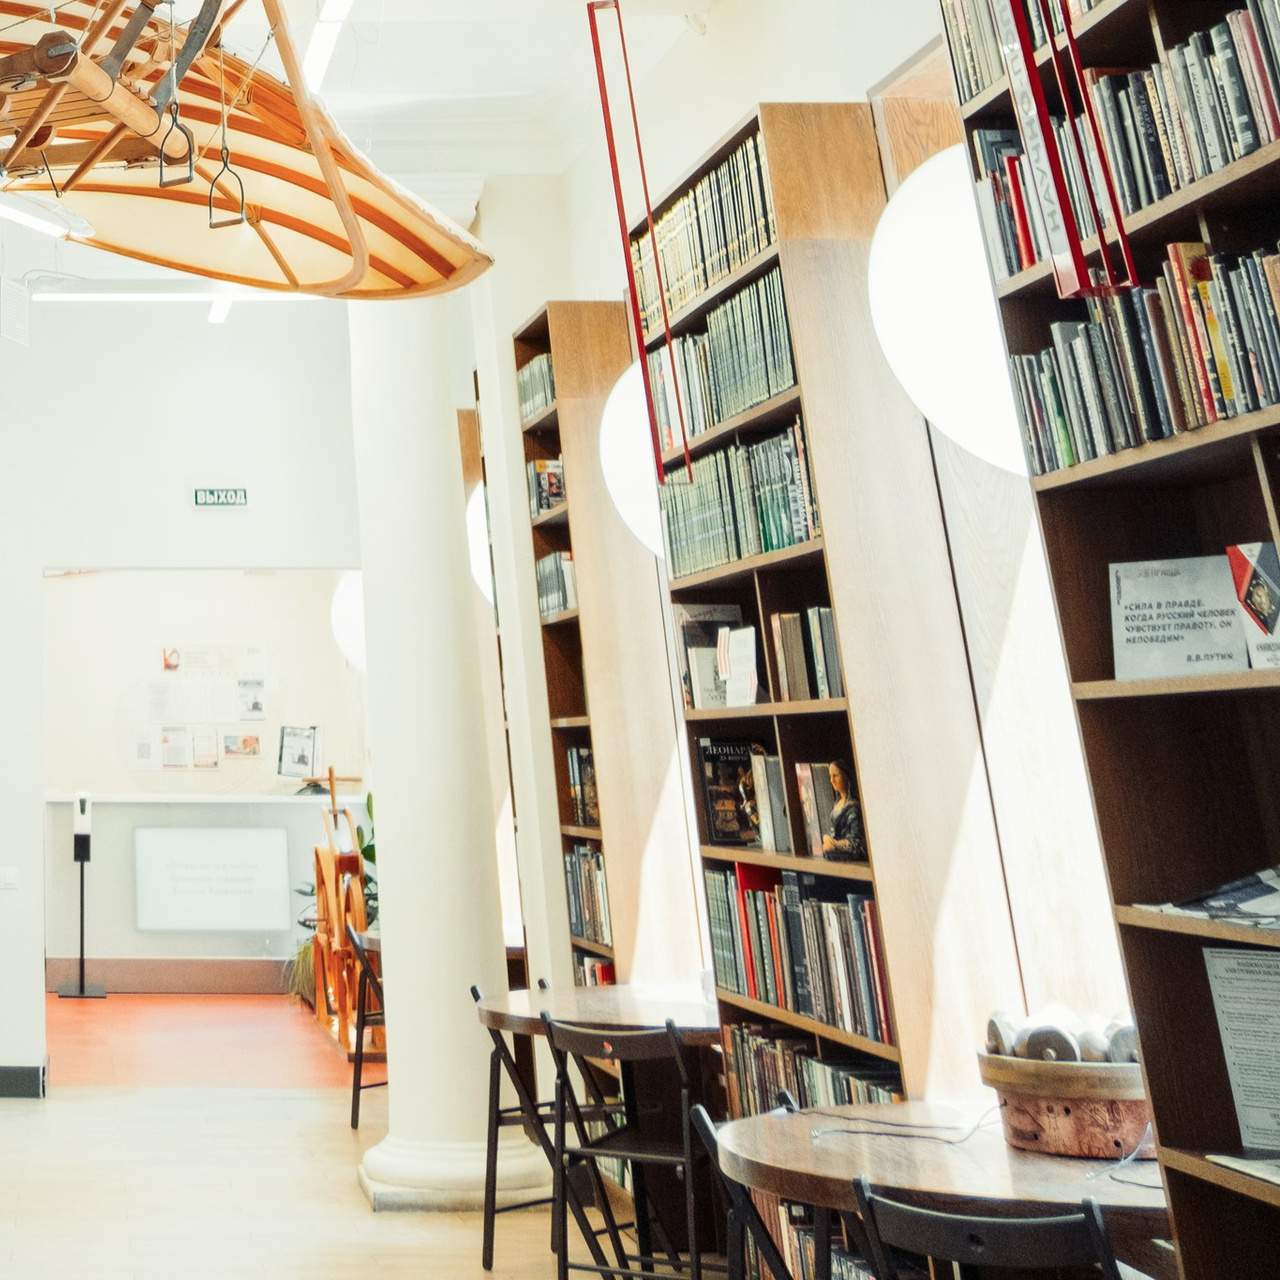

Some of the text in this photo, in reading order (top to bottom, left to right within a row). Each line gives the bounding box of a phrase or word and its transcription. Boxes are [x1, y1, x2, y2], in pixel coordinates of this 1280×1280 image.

[196, 490, 246, 504] ВЫХОД
[1124, 608, 1236, 622] КОГДА РУССКИЙ ЧЕЛОВЕК
[1125, 623, 1171, 633] ЧУВСТВУЕТ
[1219, 620, 1233, 628] ОН
